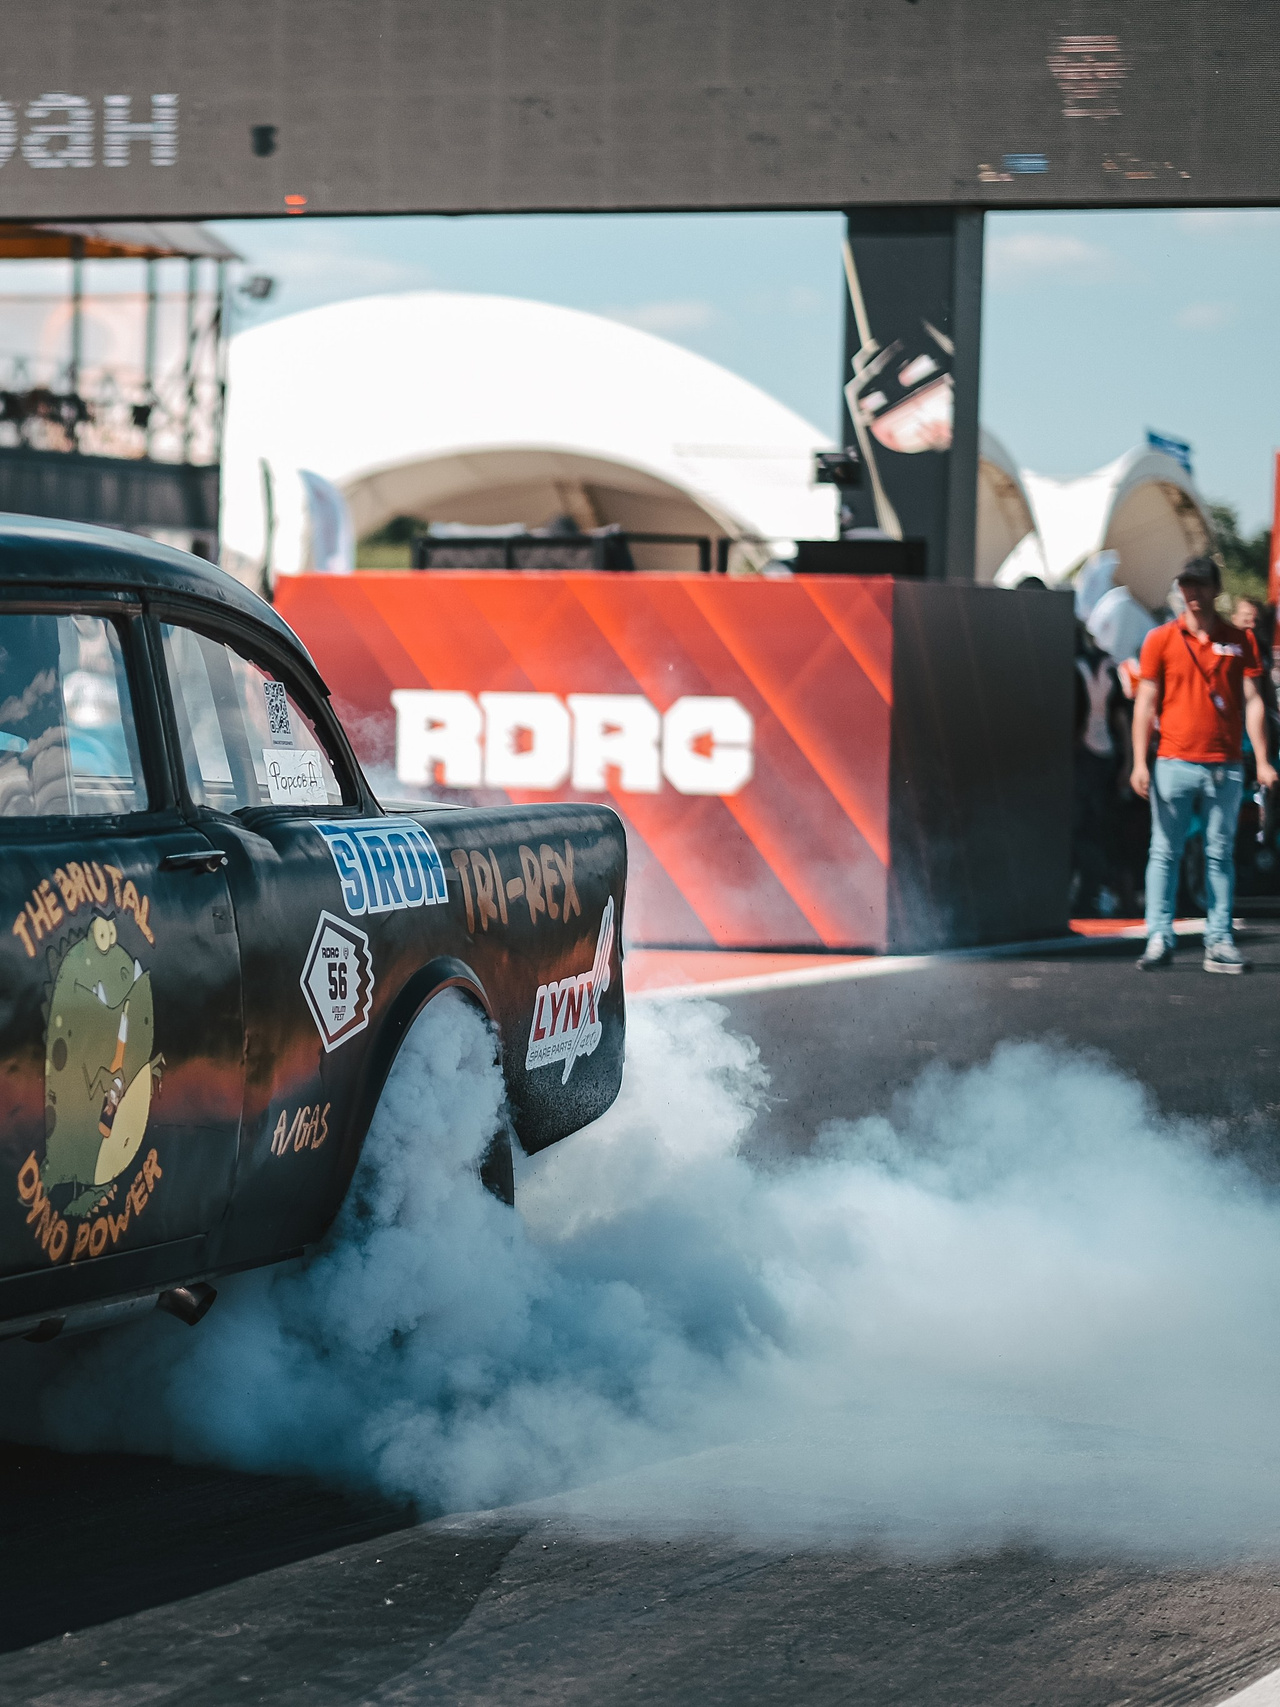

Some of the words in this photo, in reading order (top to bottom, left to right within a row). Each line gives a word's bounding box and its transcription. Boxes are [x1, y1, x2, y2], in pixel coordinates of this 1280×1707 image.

[390, 689, 754, 795] RDRC
[12, 879, 64, 958] THE
[53, 861, 156, 947] BRUTAL
[328, 828, 449, 914] SIRON
[450, 839, 581, 935] TRI-REX
[321, 947, 340, 959] RDRC
[327, 962, 348, 1000] 56
[532, 980, 596, 1043] LYNX
[70, 1148, 163, 1260] POWER
